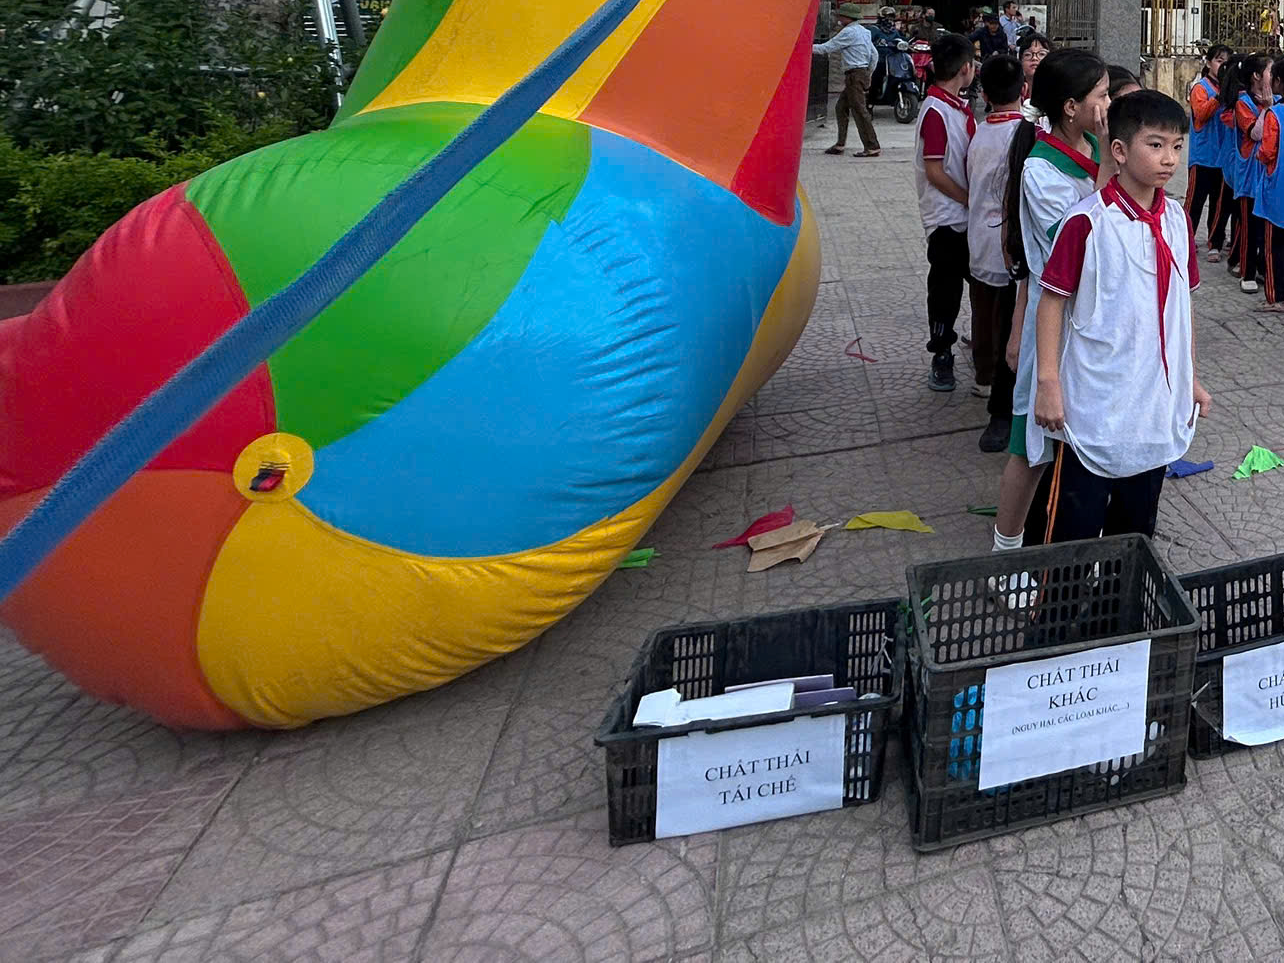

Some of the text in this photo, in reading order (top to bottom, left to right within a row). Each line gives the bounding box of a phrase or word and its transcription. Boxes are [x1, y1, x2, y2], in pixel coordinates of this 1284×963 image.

[1027, 657, 1120, 690] CHẤT THẢI
[1048, 686, 1098, 710] KHÁC
[1011, 722, 1038, 735] (NGUY
[1057, 713, 1075, 724] CÁC
[705, 748, 811, 782] CHẤT THẢI
[719, 774, 797, 805] TÁI CHẾ
